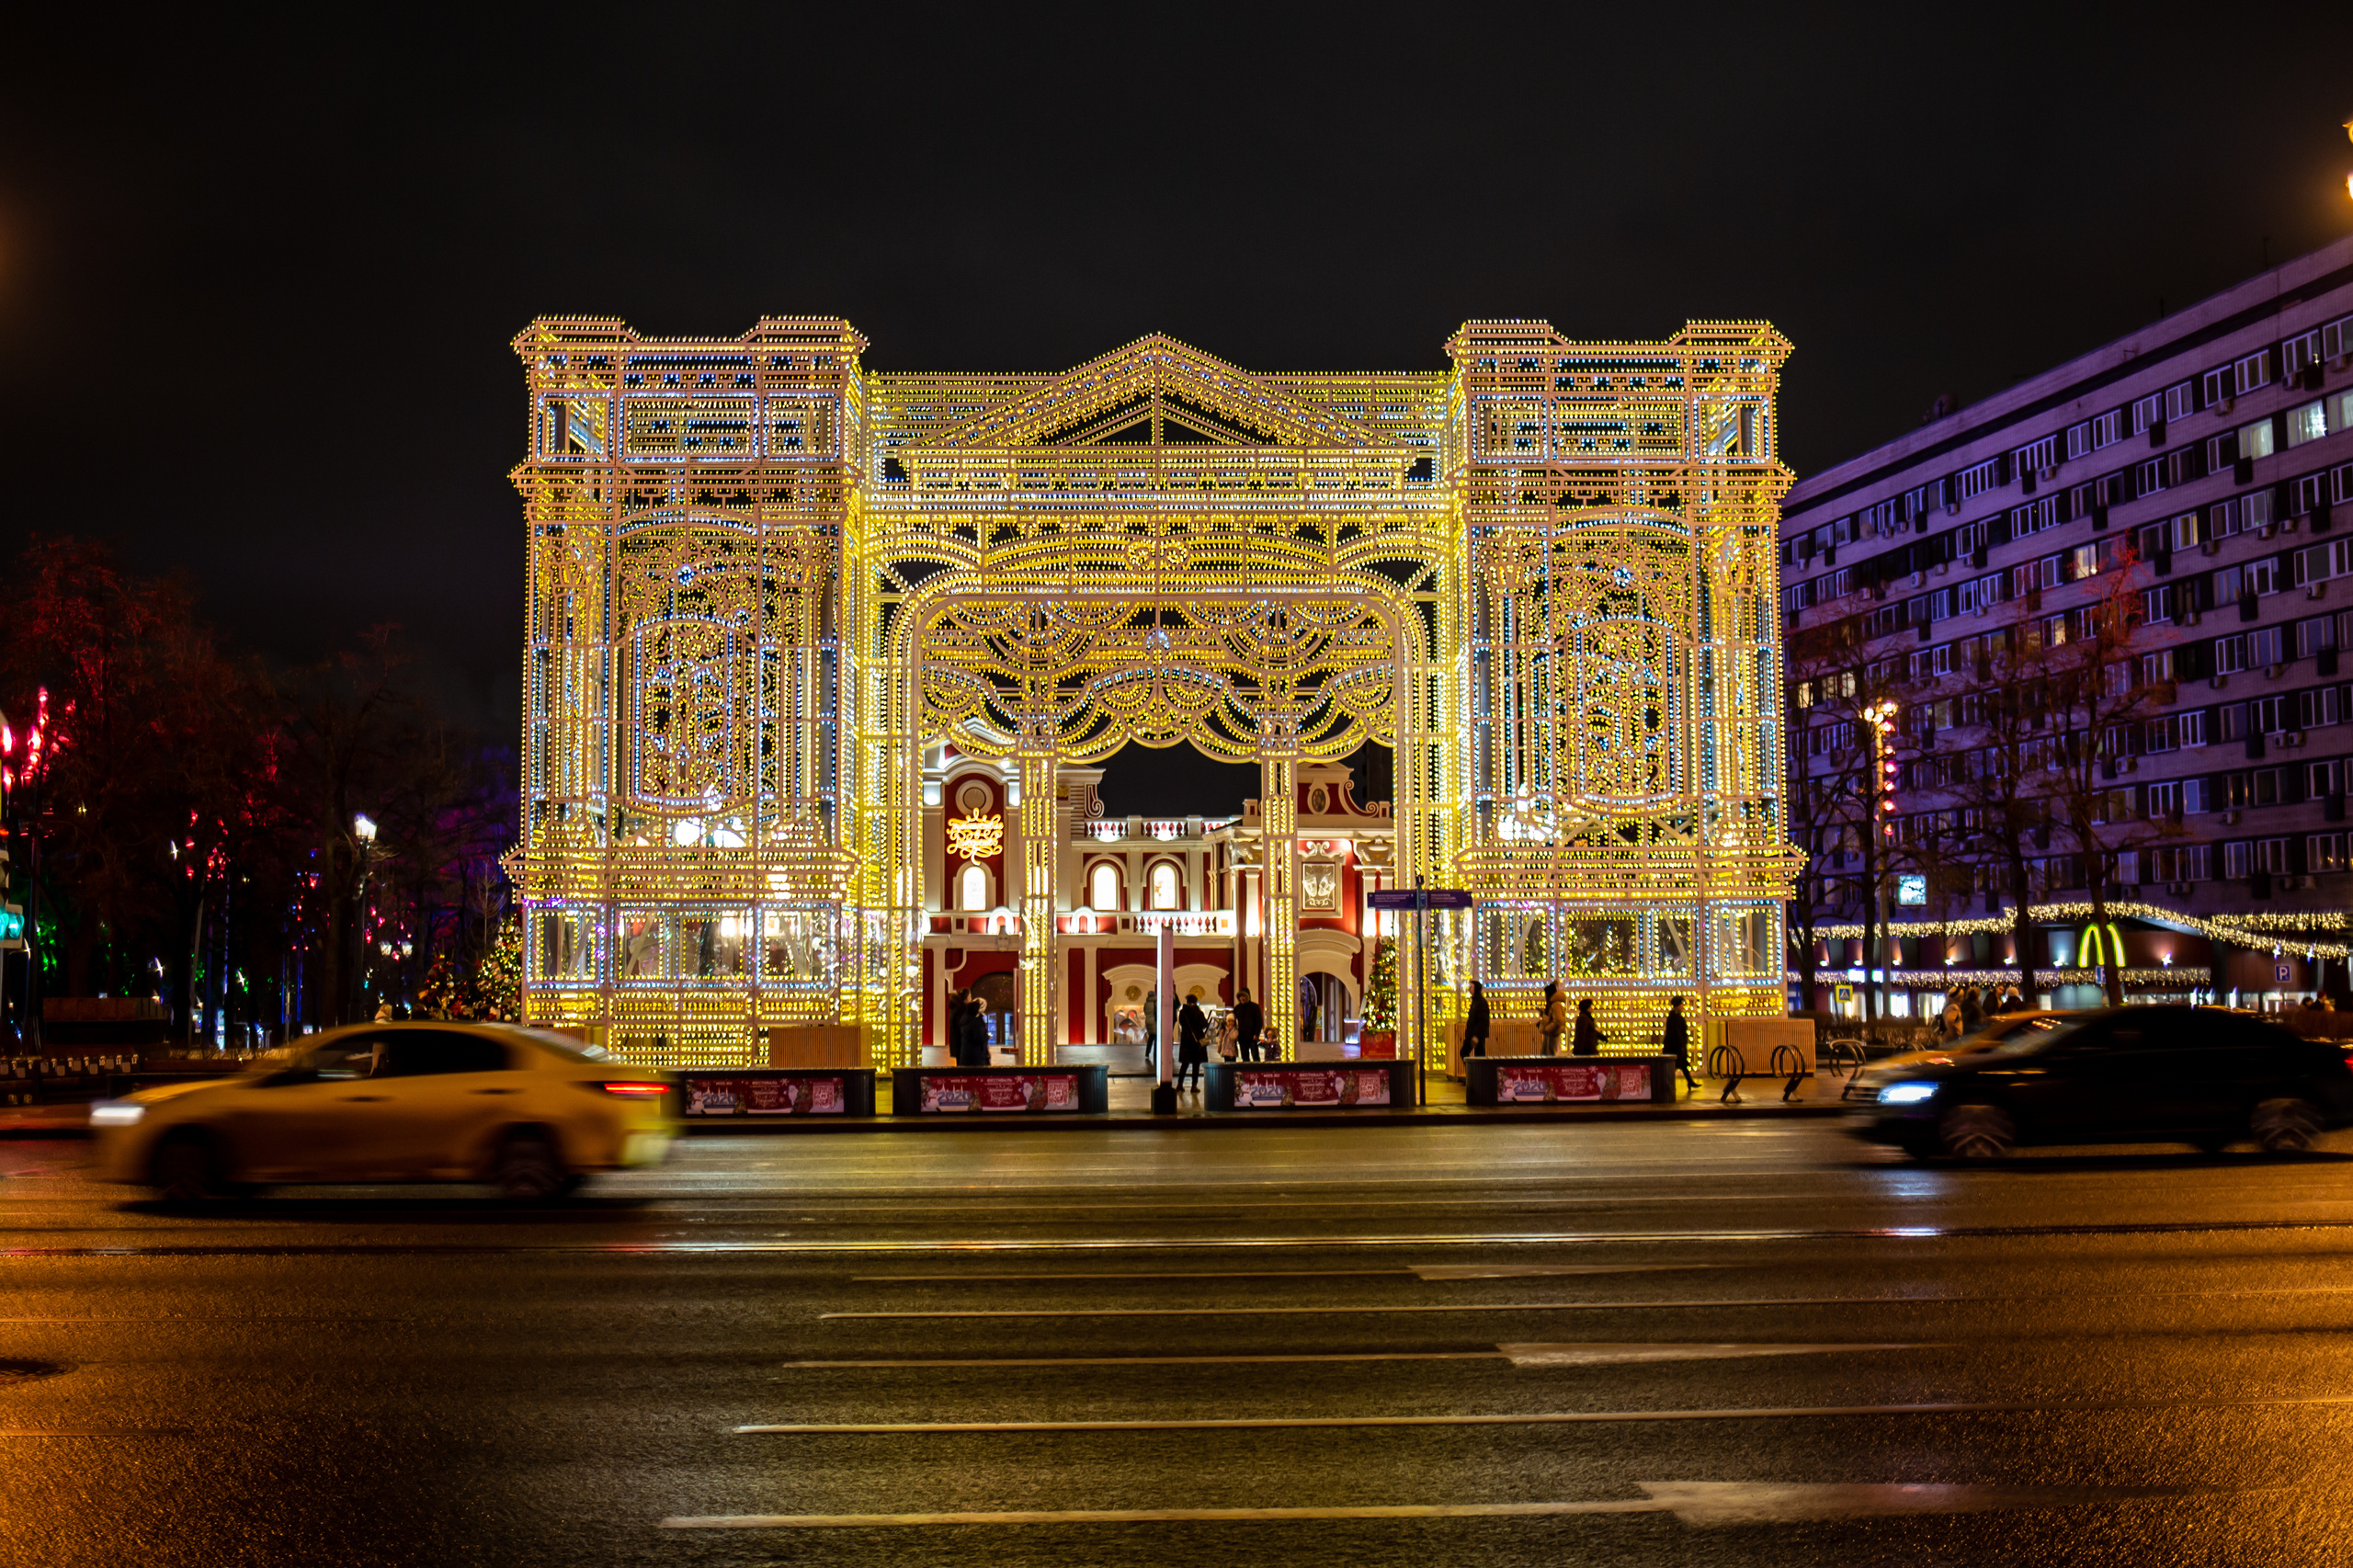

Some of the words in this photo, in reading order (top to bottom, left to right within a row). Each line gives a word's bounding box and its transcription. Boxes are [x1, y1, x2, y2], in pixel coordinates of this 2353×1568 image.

[2279, 967, 2288, 981] P
[1250, 1085, 1284, 1097] 2020
[1513, 1080, 1547, 1092] 2020
[702, 1093, 736, 1105] 2020
[938, 1090, 972, 1103] 2020
